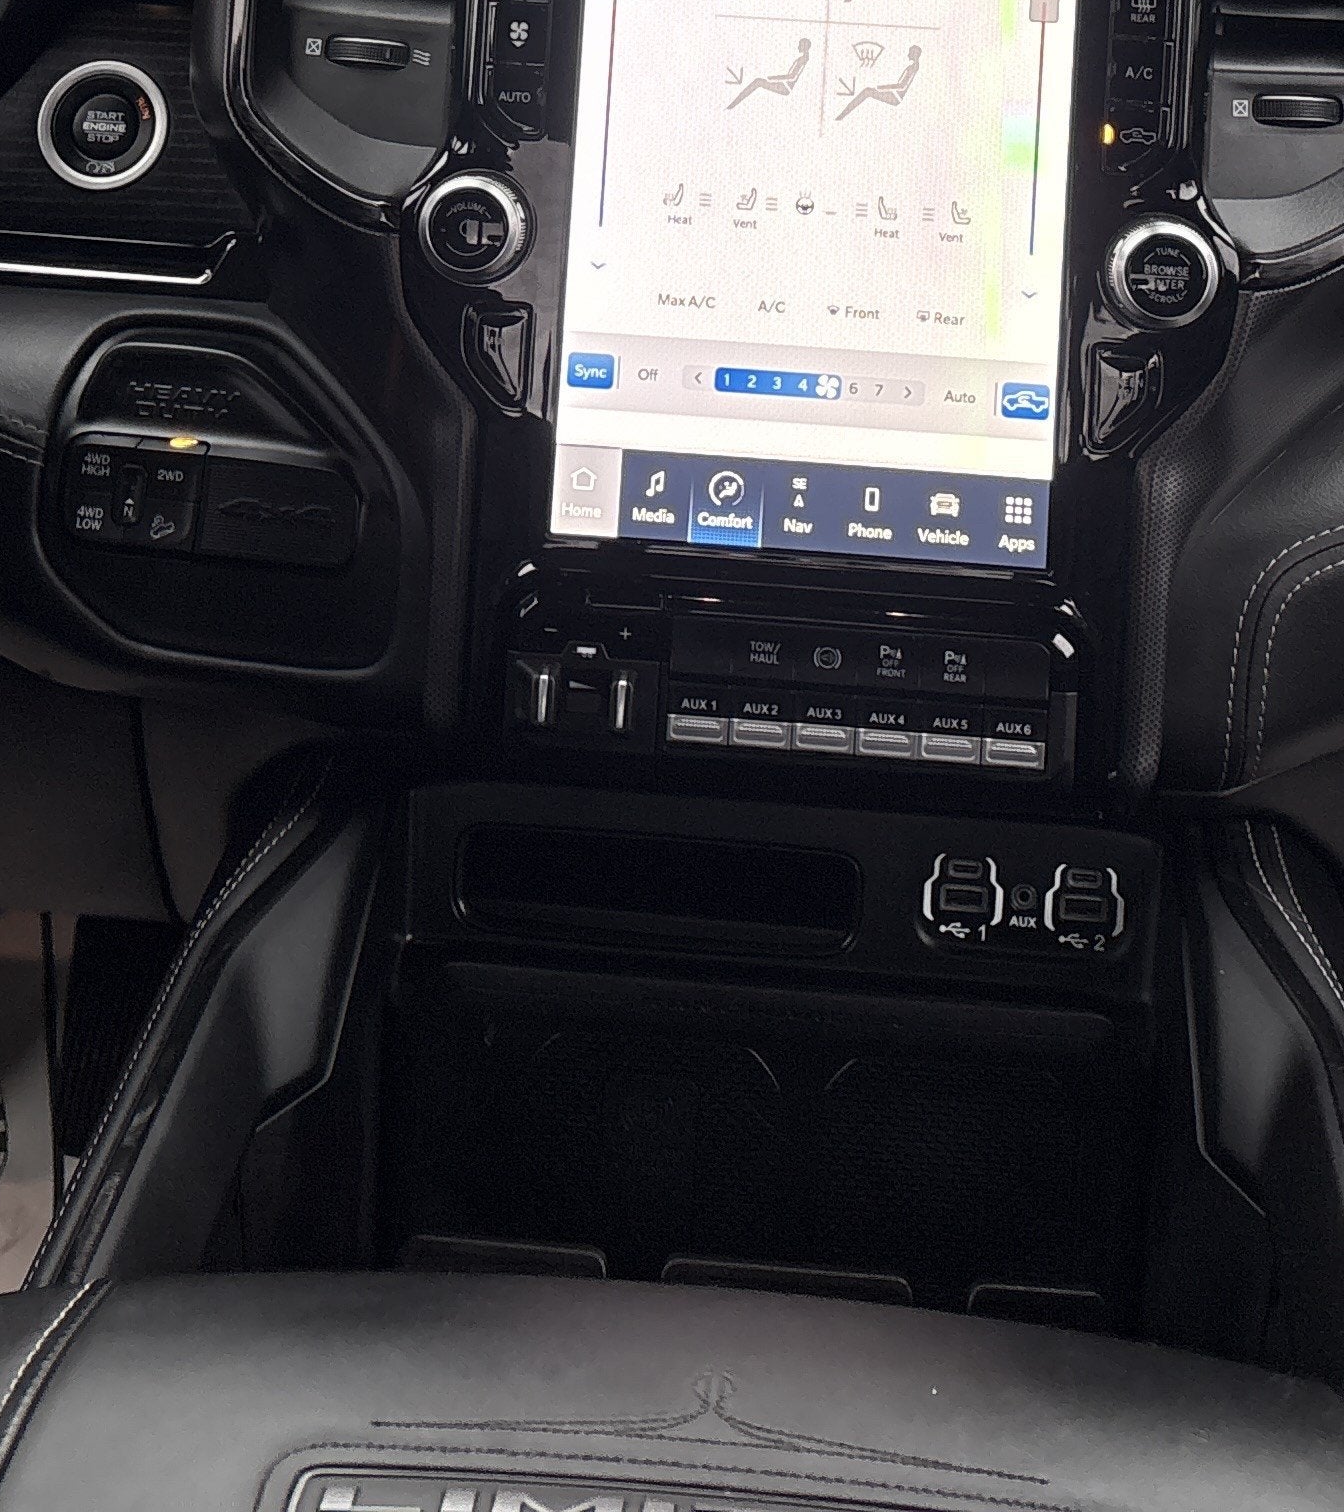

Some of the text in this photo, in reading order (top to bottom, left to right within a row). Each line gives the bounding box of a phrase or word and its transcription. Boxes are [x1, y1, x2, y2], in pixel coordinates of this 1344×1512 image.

[1130, 13, 1156, 23] REAR
[1124, 65, 1154, 80] A/C
[498, 91, 532, 103] AUTO
[86, 110, 126, 121] START
[82, 121, 127, 133] ENGINE
[86, 132, 120, 143] STOP
[450, 201, 487, 215] VOLUME
[667, 214, 693, 226] Heat
[732, 218, 758, 230] Vent
[873, 227, 900, 240] Heat
[938, 232, 965, 244] Vent
[1156, 246, 1180, 258] TUNE
[1143, 264, 1190, 277] BROWSE
[1149, 292, 1184, 304] SCROLL
[758, 300, 787, 315] A/C
[844, 305, 881, 322] Front
[933, 313, 966, 327] Rear
[573, 364, 608, 383] Sync
[637, 368, 659, 383] Off
[722, 373, 884, 398] 1 2 3 4 6 7
[943, 390, 977, 405] Auto
[84, 452, 111, 465] 4WD
[81, 463, 111, 477] HIGH
[157, 468, 184, 482] 2WD
[76, 505, 104, 519] 4WD
[123, 505, 134, 517] N
[560, 502, 602, 521] Home
[631, 507, 676, 527] Media
[75, 517, 103, 531] LOW
[697, 510, 754, 531] Comfort
[783, 518, 814, 536] Nav
[847, 522, 894, 542] Phone
[916, 526, 971, 548] Vehicle
[998, 534, 1036, 554] Apps
[750, 640, 783, 654] TOW/
[749, 653, 780, 665] HAUL
[881, 658, 899, 667] OFF
[876, 667, 906, 679] FRONT
[946, 664, 964, 673] OFF
[943, 672, 967, 683] REAR
[680, 697, 717, 711] AUX 1
[742, 702, 779, 715] AUX 2
[806, 707, 843, 720] AUX 3
[869, 712, 906, 726] AUX 4
[932, 717, 969, 730] AUX 5
[995, 722, 1032, 736] AUX 6
[1008, 914, 1038, 929] AUX
[977, 923, 987, 942] 1
[1093, 933, 1107, 952] 2
